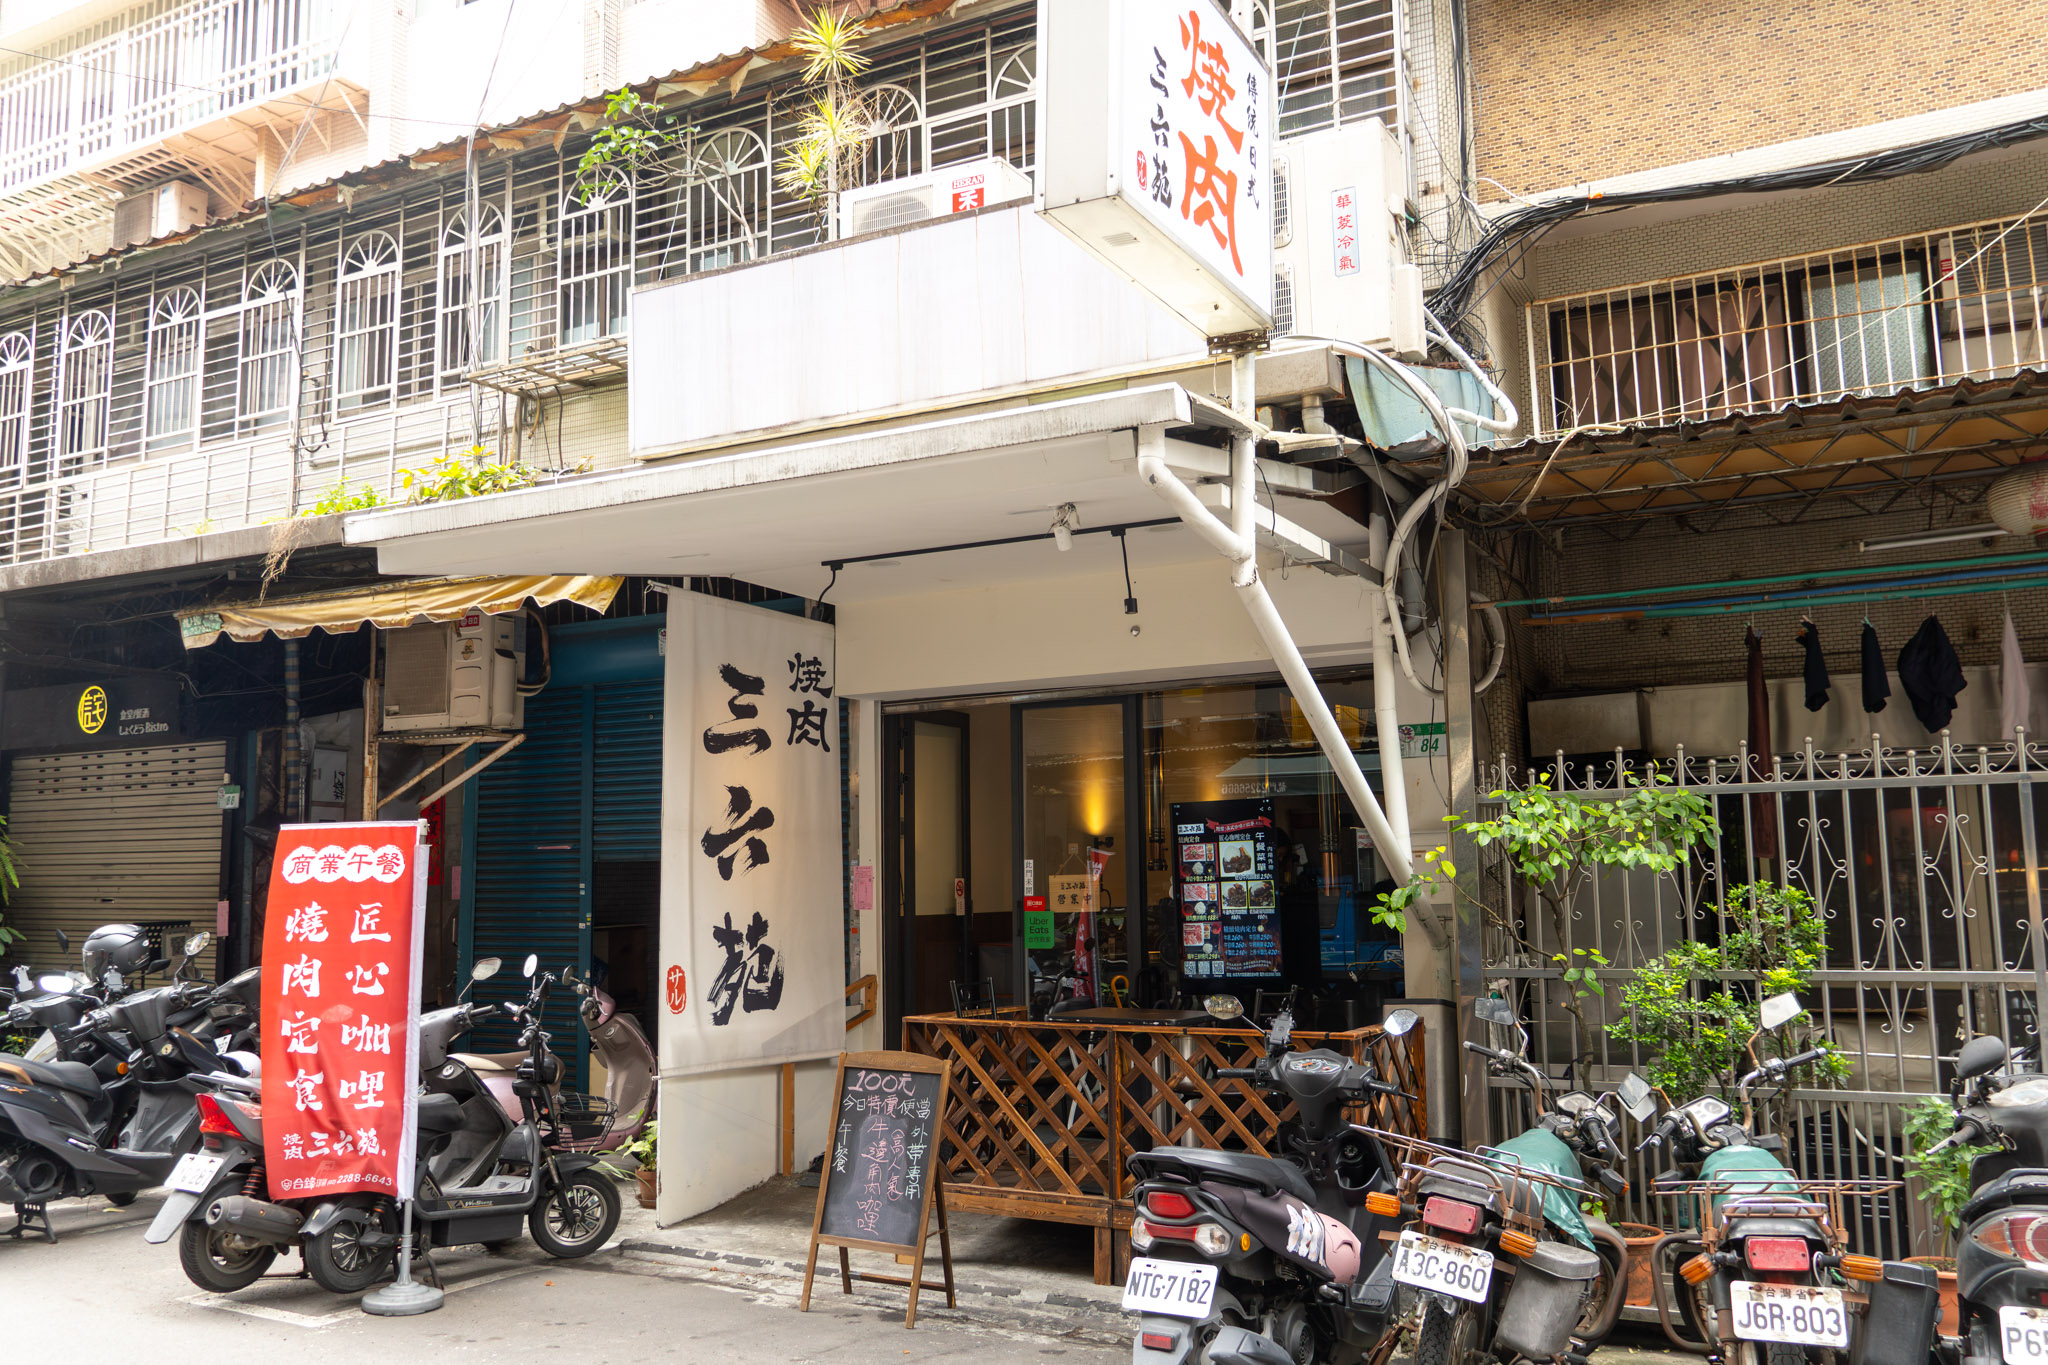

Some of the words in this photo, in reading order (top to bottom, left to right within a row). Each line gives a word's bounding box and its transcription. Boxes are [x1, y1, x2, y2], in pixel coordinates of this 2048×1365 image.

[1150, 46, 1172, 209] 三六苑
[1246, 72, 1259, 209] 傳統日式
[952, 174, 984, 189] HERAN
[1336, 194, 1355, 271] 華菱冷氣
[146, 721, 169, 733] Bistro
[1420, 738, 1439, 752] 84
[700, 663, 785, 1026] 三六苑
[288, 852, 400, 876] 商業午餐
[1029, 917, 1049, 925] Uber
[1030, 926, 1049, 934] Eats
[666, 967, 687, 1013] サル
[339, 902, 391, 1109] 匠心咖哩
[848, 1070, 916, 1097] 100元
[842, 1094, 931, 1120] 今日特價便當
[832, 1119, 852, 1174] 午餐
[905, 1122, 929, 1200] 外帶專用
[337, 1174, 392, 1186] 2288-6643
[1428, 1242, 1464, 1258] 台北市
[1764, 1286, 1807, 1301] 台灣省
